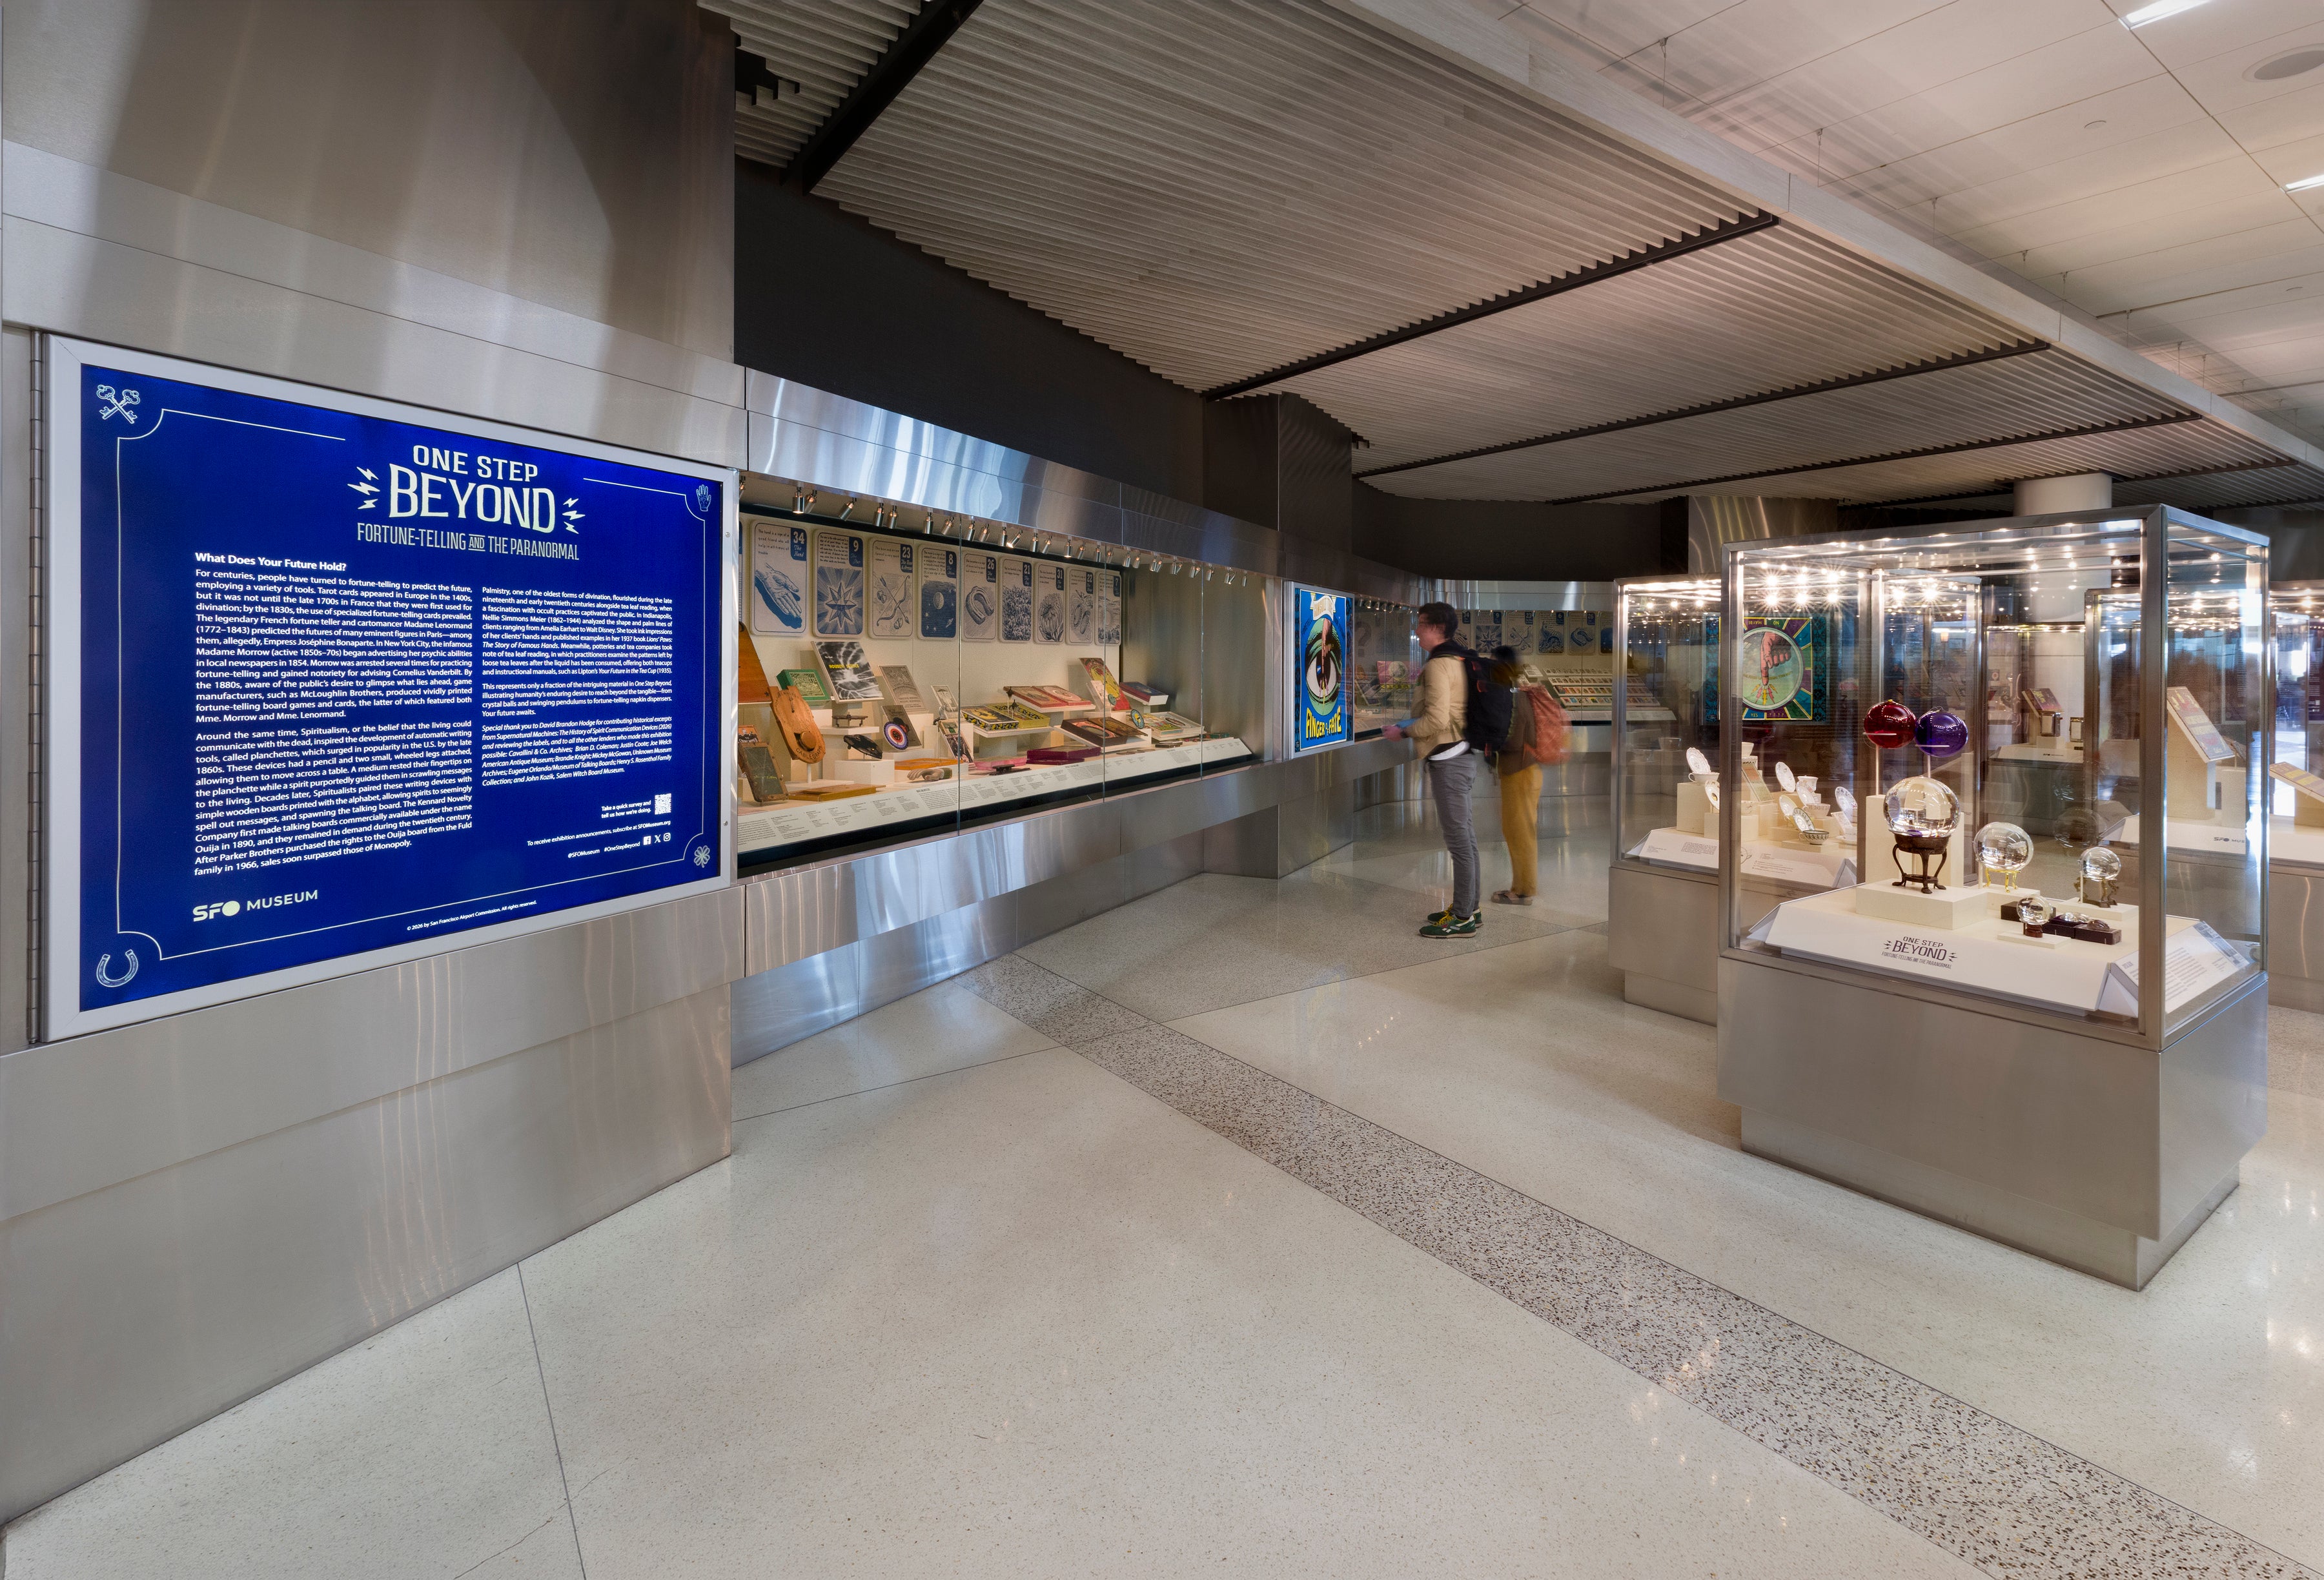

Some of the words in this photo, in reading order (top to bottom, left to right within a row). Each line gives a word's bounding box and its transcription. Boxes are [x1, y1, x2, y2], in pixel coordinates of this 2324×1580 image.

[413, 445, 468, 475] ONE
[476, 456, 538, 482] STEP
[389, 463, 555, 533] BEYOND
[357, 522, 466, 550] FORTUNE-TELLING
[469, 535, 485, 549] AND
[488, 536, 508, 554] THE
[511, 539, 579, 560] PARANORMAL
[793, 531, 804, 544] 34
[853, 540, 859, 551] 9
[902, 546, 910, 558] 23
[949, 554, 953, 564] 8
[194, 552, 226, 564] What
[227, 555, 256, 566] Does
[257, 557, 283, 567] Your
[284, 559, 318, 569] Future
[319, 561, 347, 571] Hold?
[988, 559, 994, 569] 26
[1024, 564, 1030, 575] 21
[196, 568, 211, 577] For
[212, 571, 256, 580] centuries,
[258, 573, 287, 582] people
[289, 574, 309, 583] have
[310, 576, 337, 585] turned
[348, 578, 401, 590] fortune-telling
[451, 584, 473, 593] future,
[1057, 569, 1063, 579] 31
[1087, 573, 1092, 582] 22
[482, 586, 511, 596] Palmistry,
[584, 593, 612, 601] divination,
[637, 595, 654, 604] during
[195, 613, 214, 622] The
[214, 614, 259, 625] legendary
[260, 615, 289, 624] French
[289, 617, 320, 625] fortune
[403, 620, 434, 628] Madame
[434, 621, 473, 630] Lenormand
[196, 731, 231, 741] Around
[233, 731, 249, 739] the
[300, 726, 350, 737] Spiritualism,
[378, 723, 400, 732] belief
[431, 721, 451, 730] living
[1306, 707, 1325, 739] FINGER
[1329, 705, 1341, 734] FATE
[482, 777, 513, 786] Collection;
[587, 768, 604, 776] Board
[551, 834, 575, 843] exhibition
[575, 829, 612, 839] announcements,
[612, 825, 633, 834] subscribe
[637, 820, 671, 830] SFOMuseum.org
[567, 849, 600, 859] @SFOMuseum
[604, 841, 640, 852] #OneStepBeyond
[192, 901, 240, 921] SFO
[247, 890, 318, 911] MUSEUM
[474, 908, 502, 917] Commission.
[518, 899, 537, 908] reserved.
[1892, 940, 1947, 961] BEYOND
[1926, 959, 1952, 969] PARANORMAL
